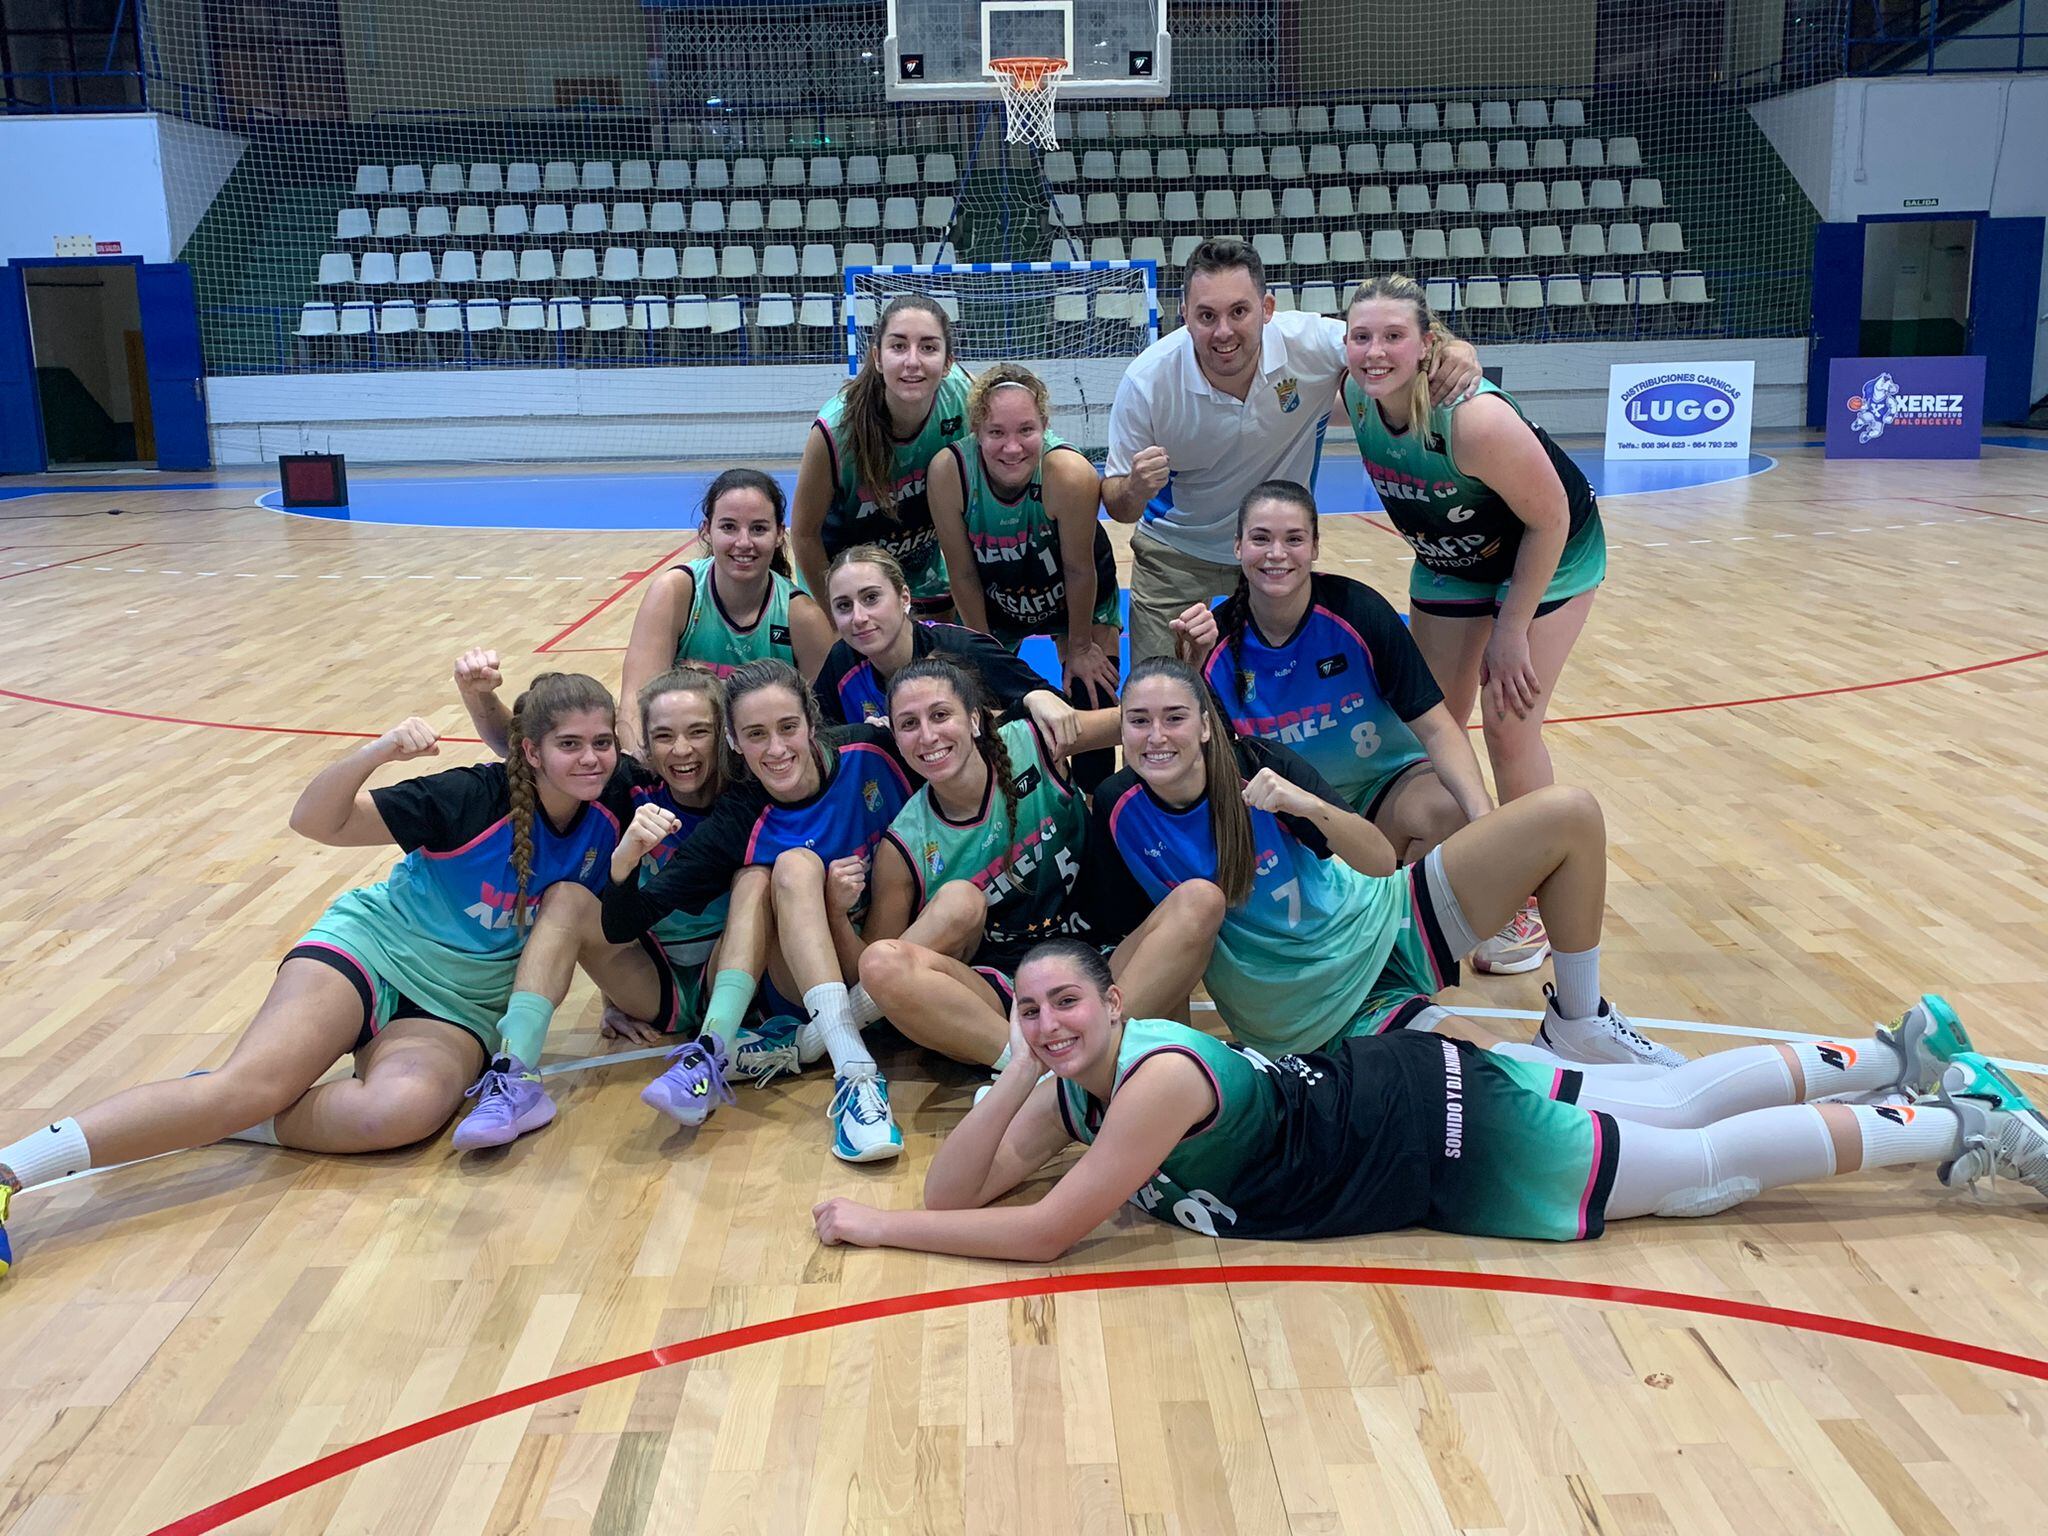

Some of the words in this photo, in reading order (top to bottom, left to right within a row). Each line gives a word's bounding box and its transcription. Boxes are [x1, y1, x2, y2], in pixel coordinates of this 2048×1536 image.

[1621, 373, 1696, 402] DISTRIBUCIONES
[1697, 374, 1741, 400] CARNICAS
[1631, 399, 1730, 421] LUGO
[1896, 395, 1964, 412] XEREZ
[1446, 504, 1476, 523] 6
[1038, 547, 1058, 577] 1
[1350, 721, 1382, 758] 8
[1054, 846, 1081, 896] 5
[1271, 877, 1301, 929] 7
[1446, 1074, 1462, 1090] DJ
[1446, 1089, 1463, 1100] Y
[1445, 1102, 1463, 1159] SONIDO
